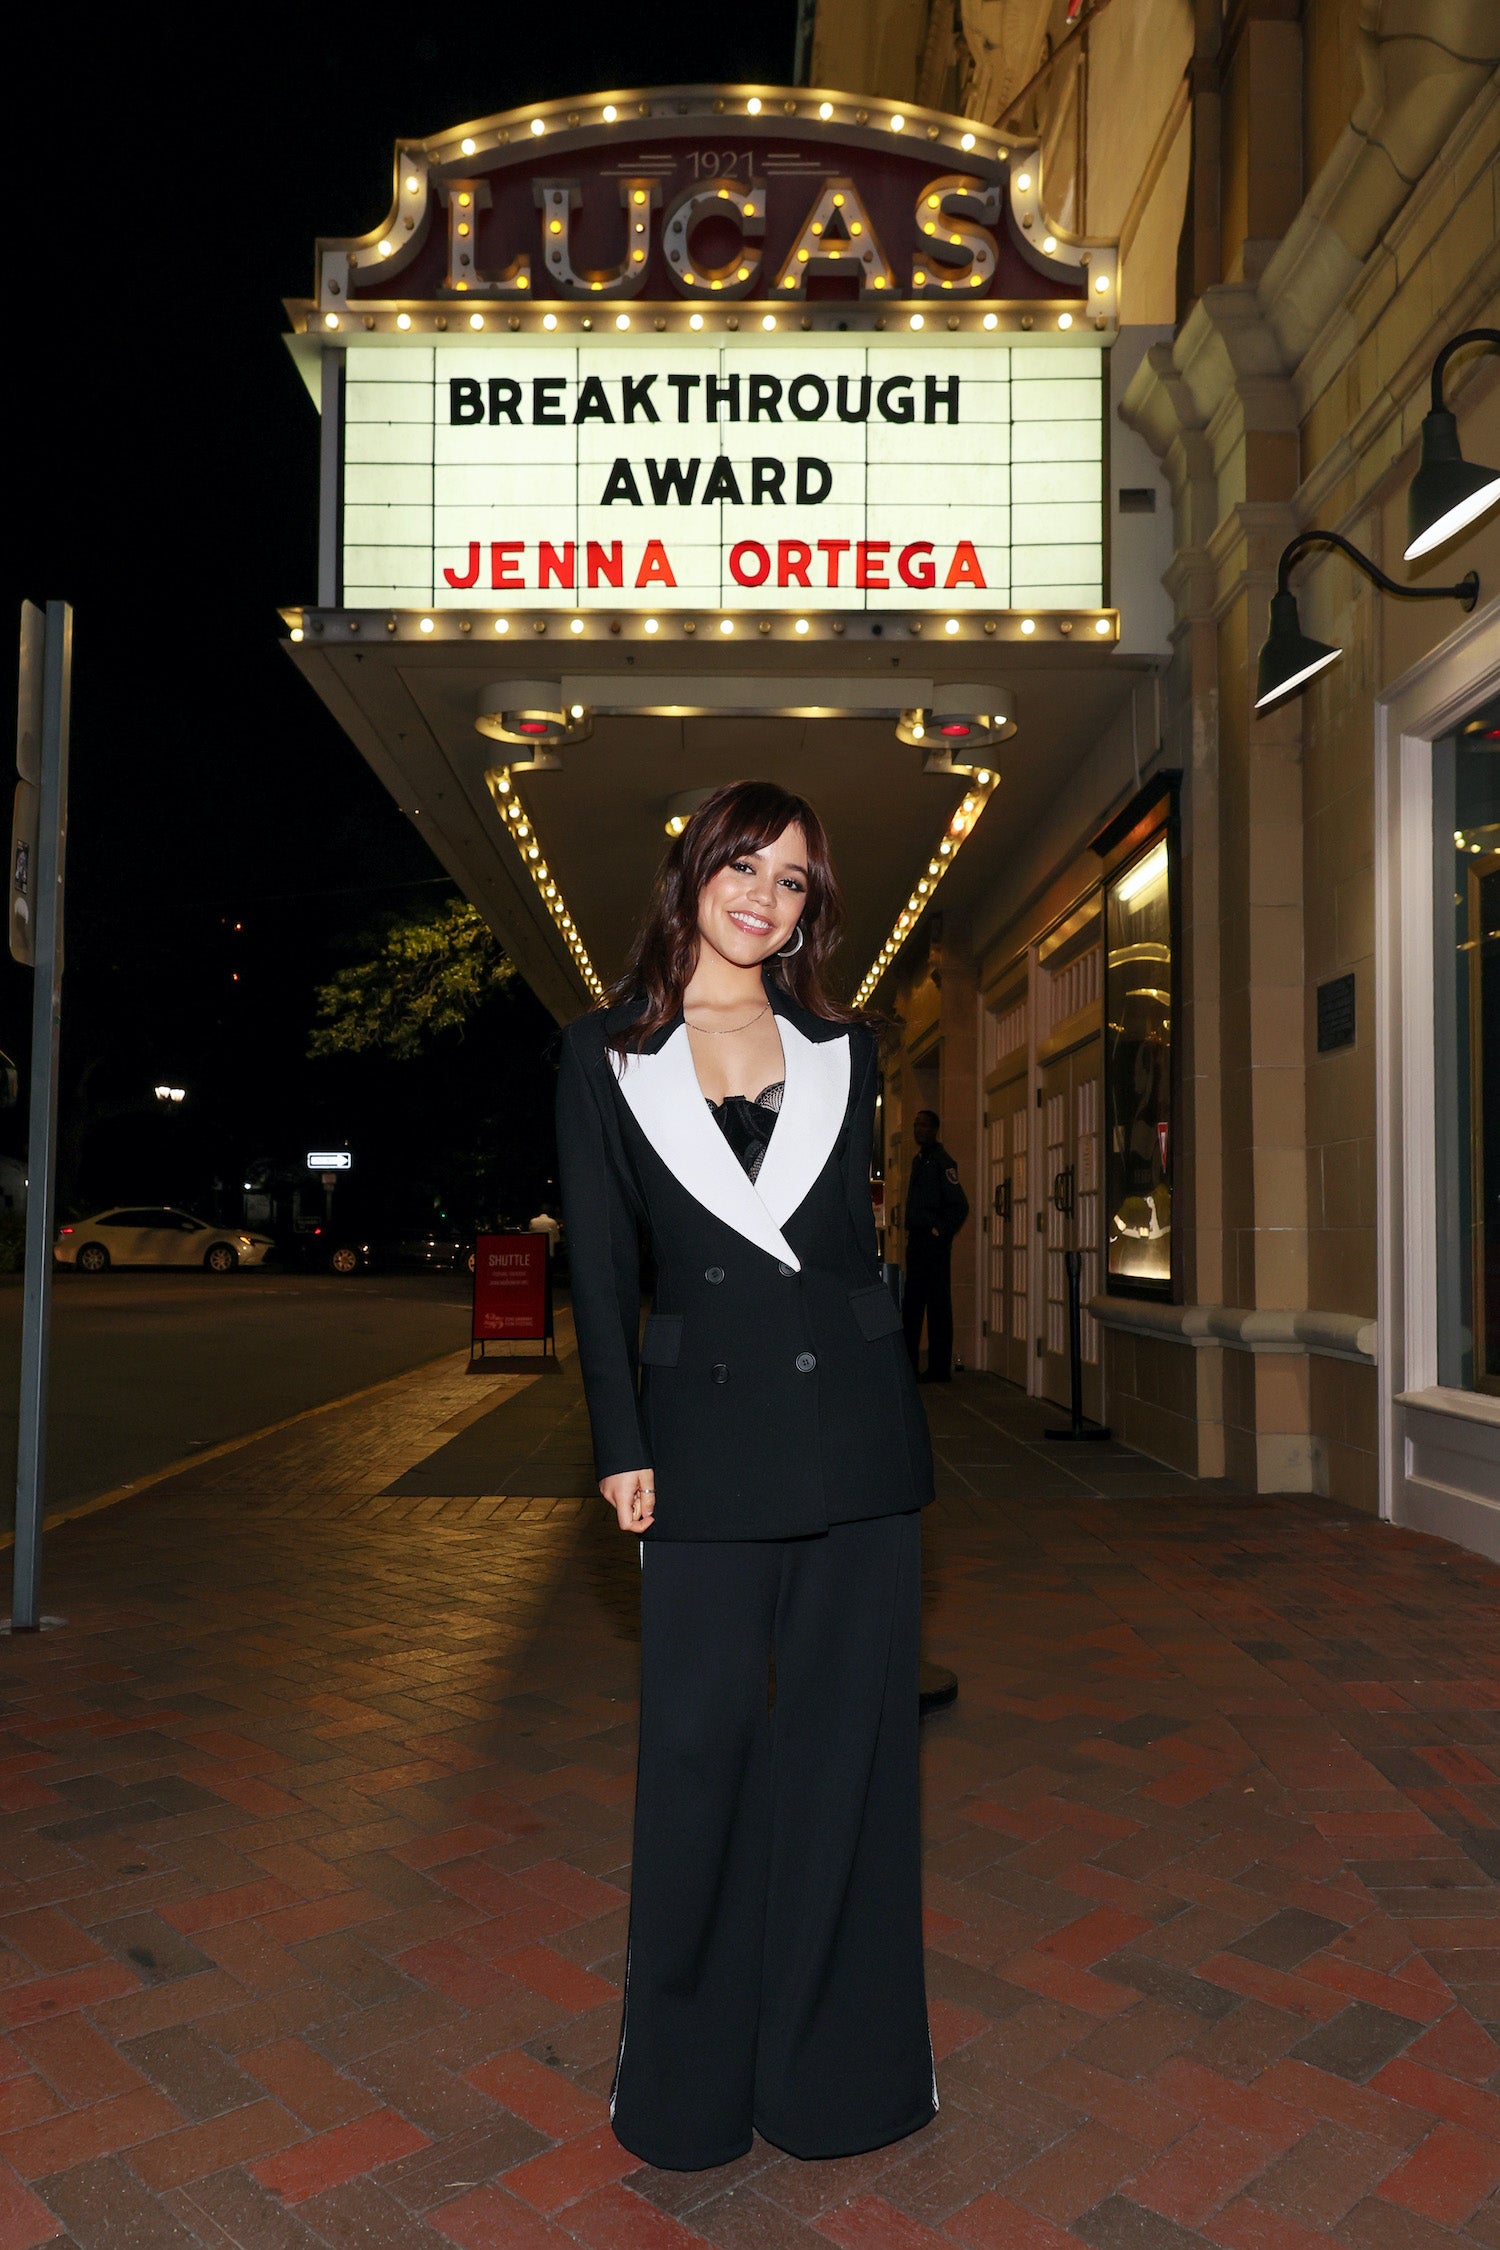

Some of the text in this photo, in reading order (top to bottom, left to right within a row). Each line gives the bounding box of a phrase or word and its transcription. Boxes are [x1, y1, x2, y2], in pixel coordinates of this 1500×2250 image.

[686, 150, 754, 179] 1921
[439, 173, 1001, 300] LUCAS
[448, 373, 960, 426] BREAKTHROUGH
[601, 455, 834, 506] AWARD
[443, 538, 987, 589] JENNA ORTEGA
[488, 1253, 531, 1266] SHUTTLE
